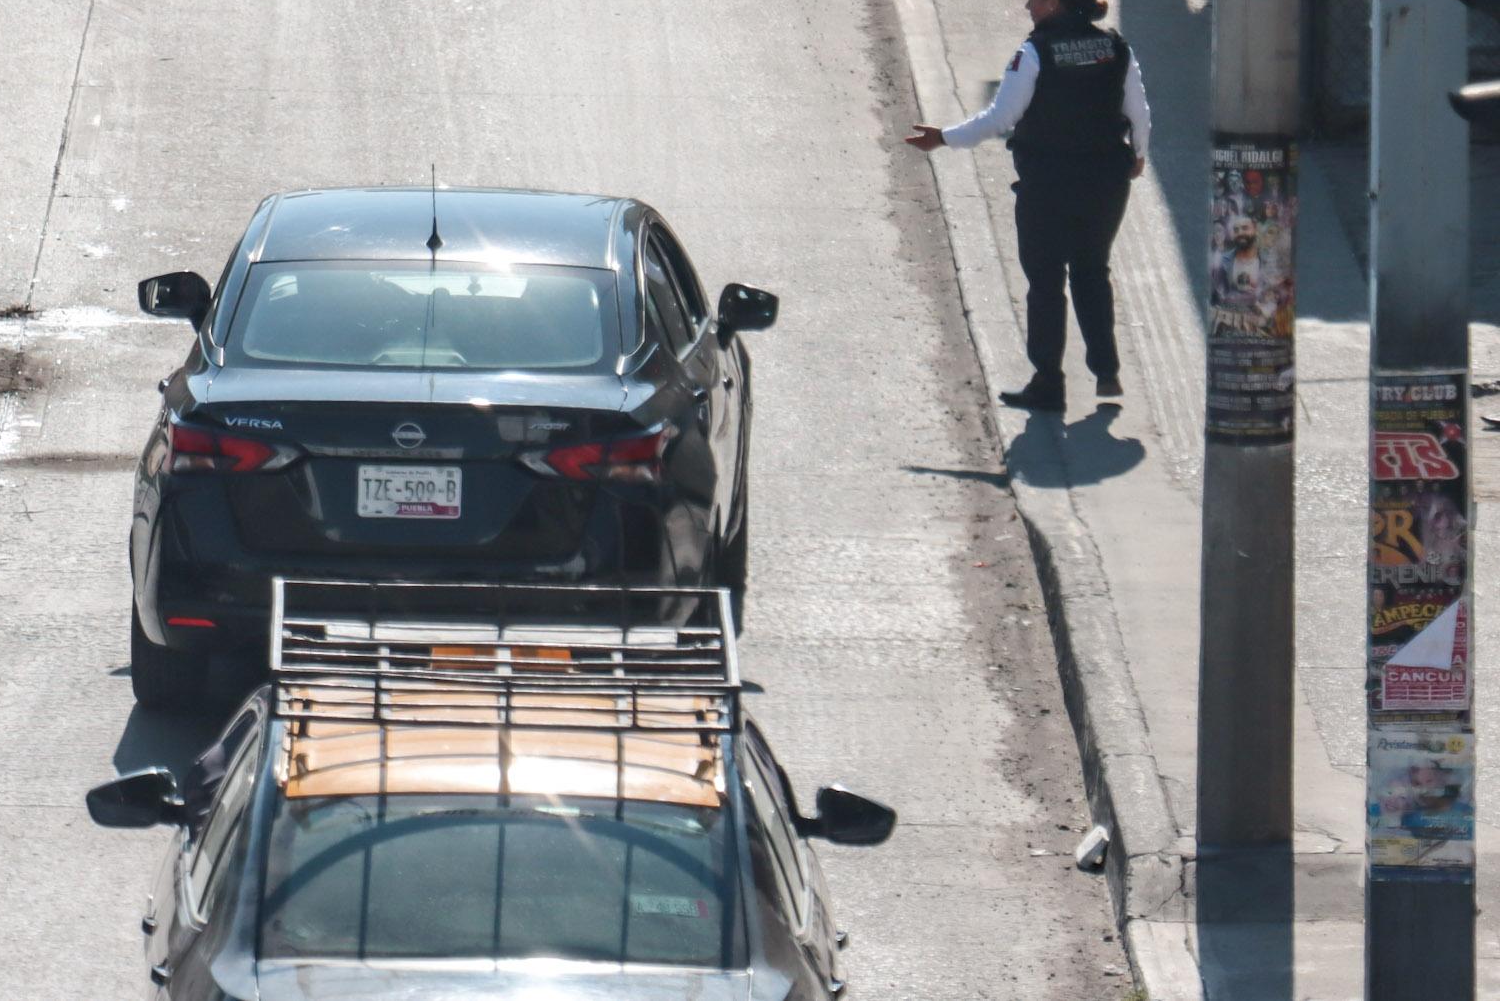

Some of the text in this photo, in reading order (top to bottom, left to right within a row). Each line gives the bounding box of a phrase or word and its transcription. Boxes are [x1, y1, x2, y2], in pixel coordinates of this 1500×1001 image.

[1411, 384, 1457, 401] CLUB
[225, 417, 284, 430] VERSA
[363, 479, 457, 503] TZE-509-B
[401, 504, 433, 512] PUEBLA
